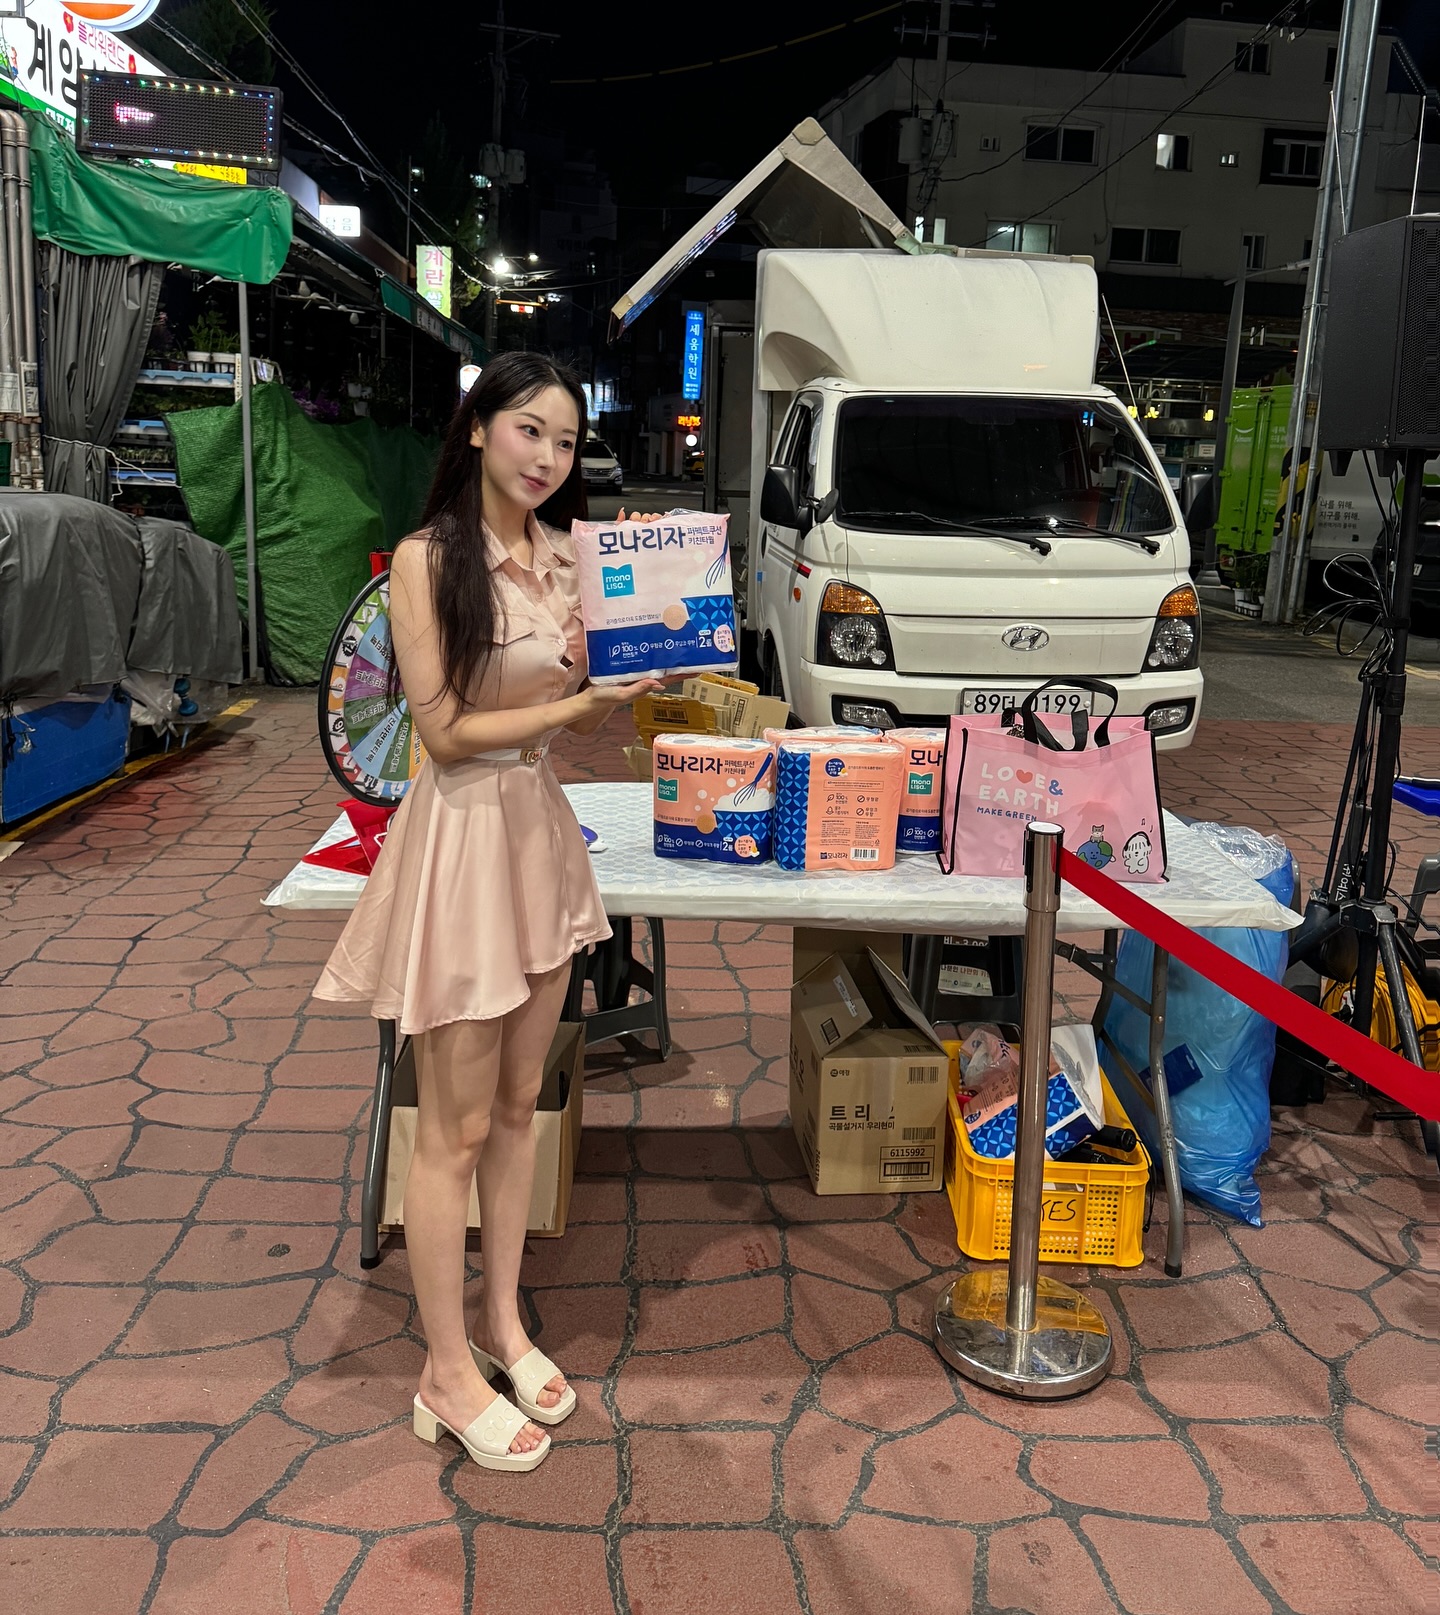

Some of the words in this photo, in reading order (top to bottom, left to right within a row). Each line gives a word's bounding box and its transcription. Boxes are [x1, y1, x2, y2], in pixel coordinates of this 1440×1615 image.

[424, 250, 444, 286] 계란
[688, 324, 701, 380] 세움학원
[1319, 500, 1335, 509] 나를
[1319, 511, 1341, 521] 지구를
[599, 526, 686, 556] 모나리자
[687, 525, 723, 536] 퍼펙트쿠션
[688, 537, 715, 546] 키친타월
[605, 573, 631, 583] mona
[974, 694, 1015, 714] 89더
[365, 717, 397, 763] 진라면멀티팩
[657, 753, 723, 775] 모나리자
[724, 760, 755, 769] 퍼펙트쿠션
[724, 767, 746, 775] 키친타월
[978, 784, 1059, 816] EARTH
[976, 806, 1003, 817] MAKE
[829, 1122, 865, 1131] 곡물설거지
[866, 1121, 895, 1130] 우리현미
[890, 1147, 925, 1158] 6115992
